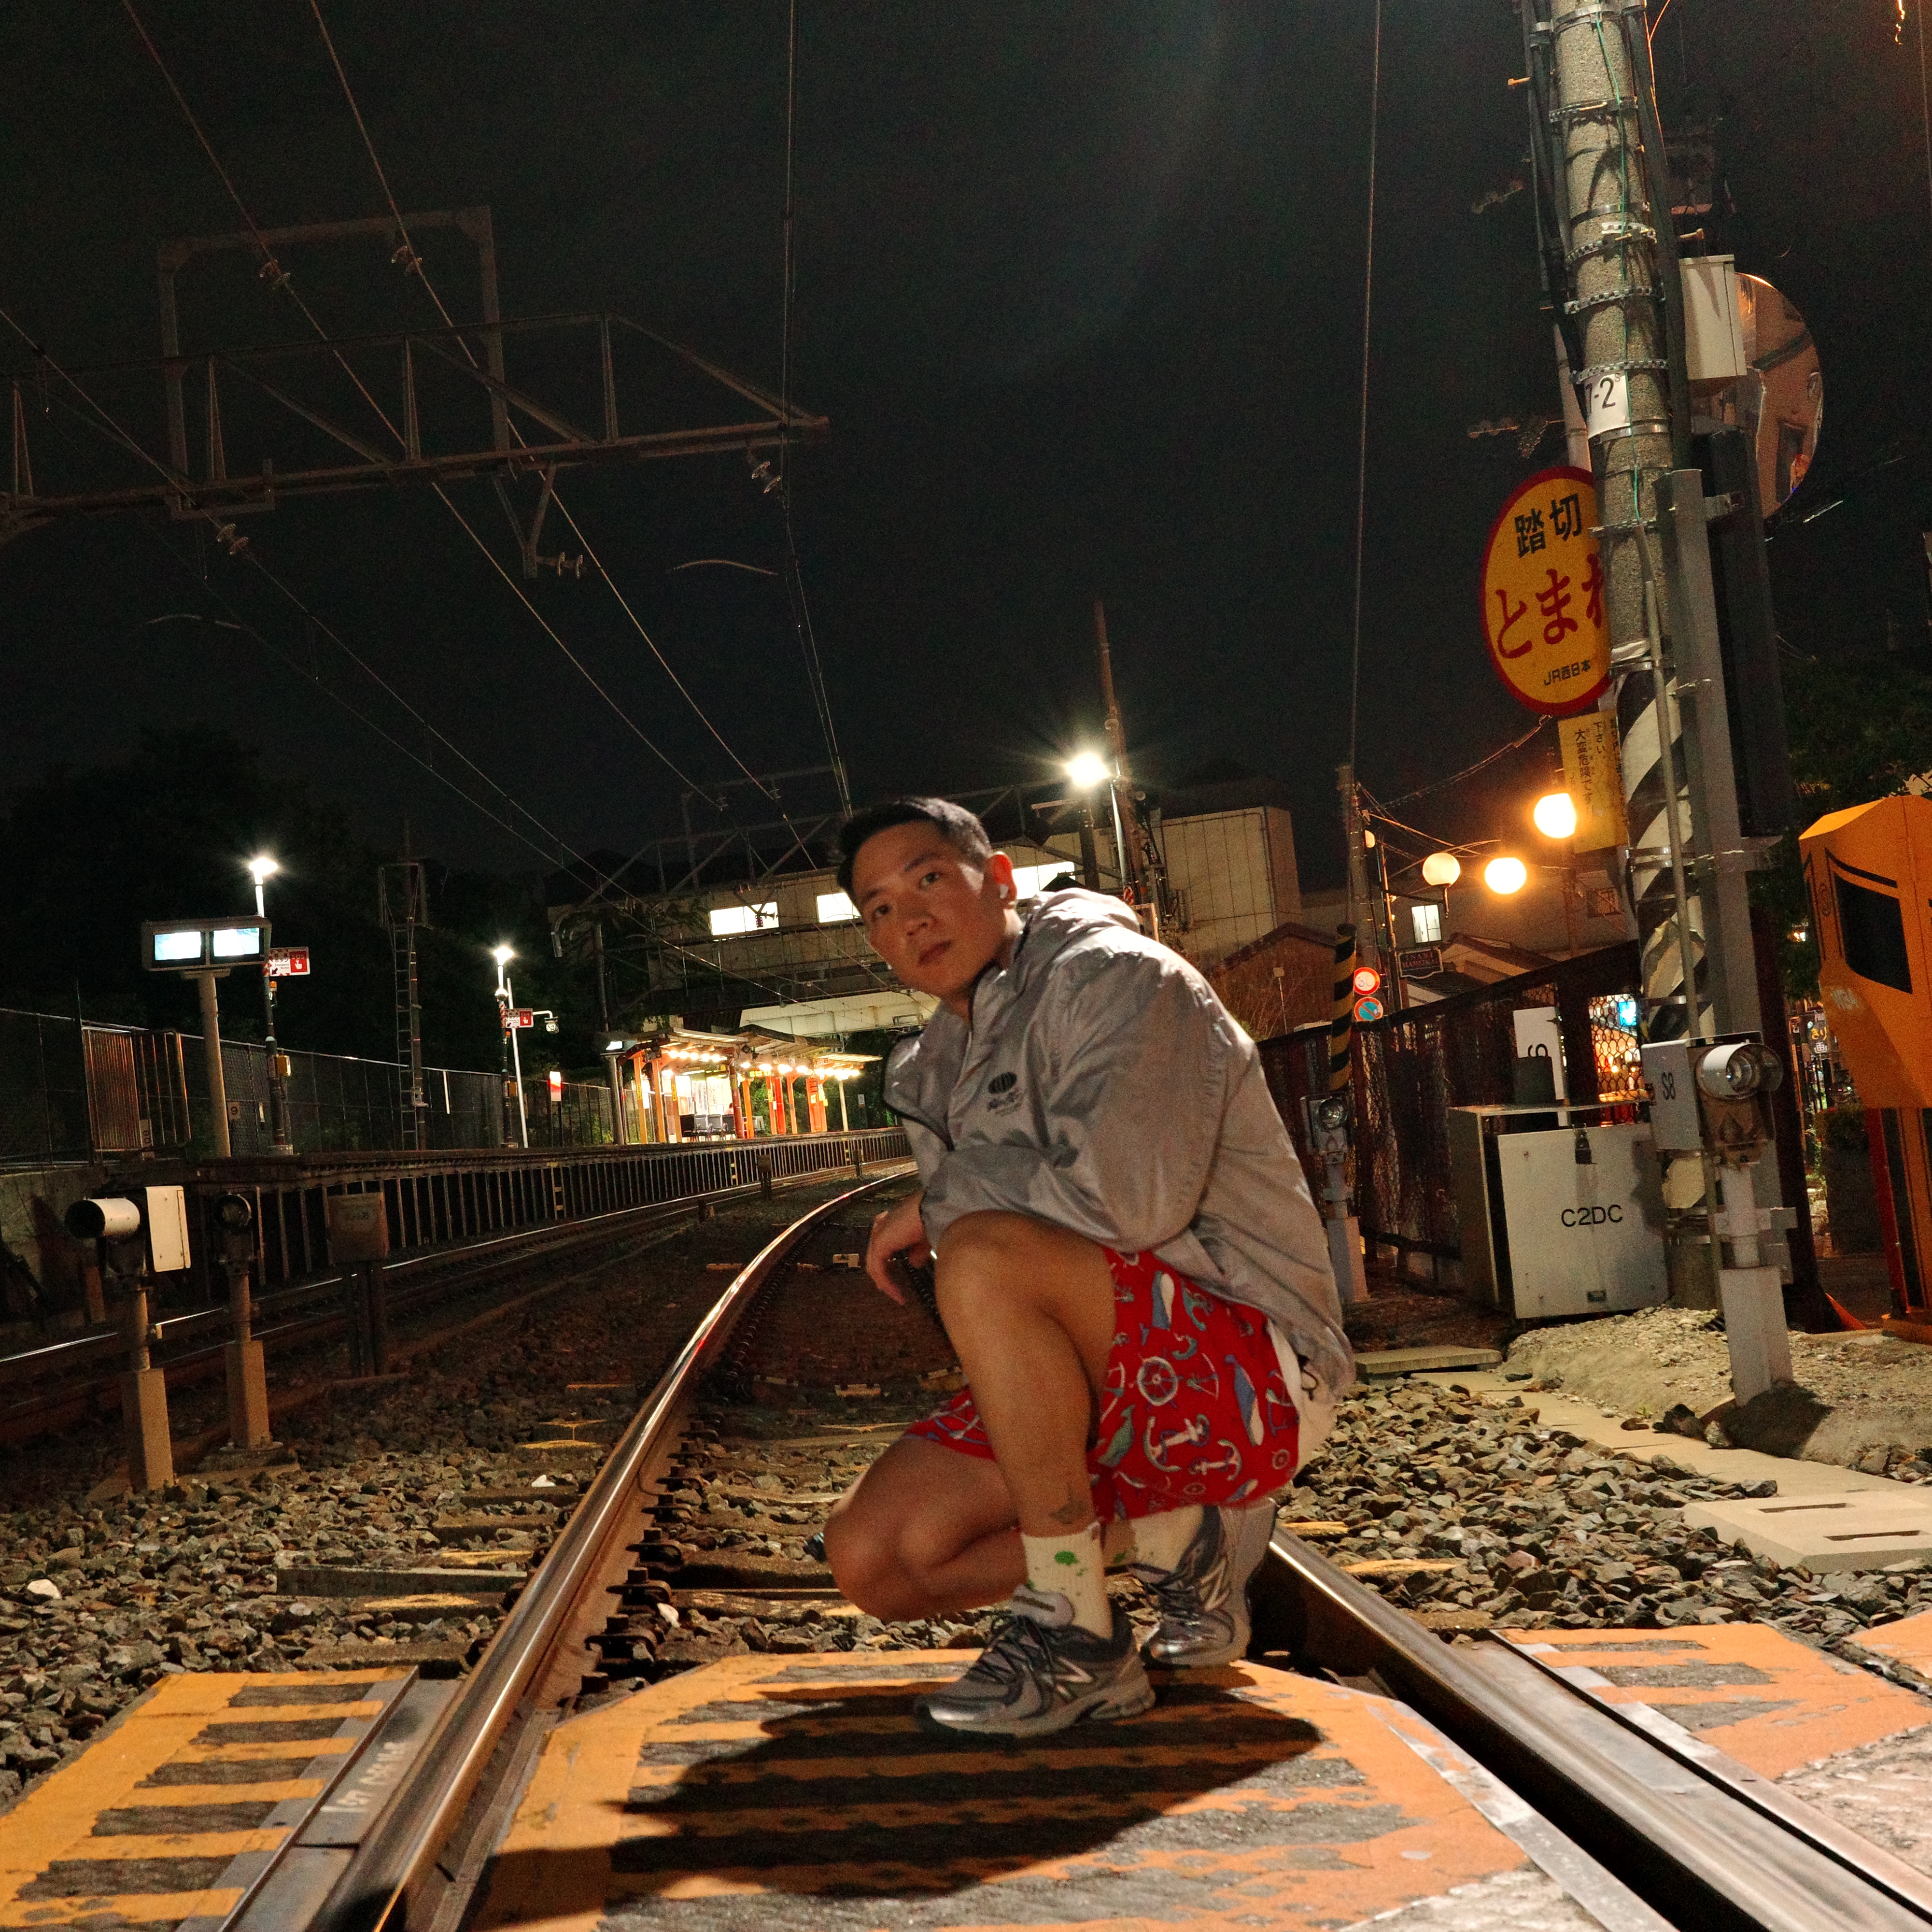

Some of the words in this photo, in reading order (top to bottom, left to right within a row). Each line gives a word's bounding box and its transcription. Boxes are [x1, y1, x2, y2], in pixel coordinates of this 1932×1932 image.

[1514, 493, 1582, 558] 踏切
[1544, 659, 1591, 686] JR西日本
[1358, 976, 1373, 987] 30
[1662, 1072, 1676, 1100] S8
[1561, 1204, 1623, 1227] C2DC
